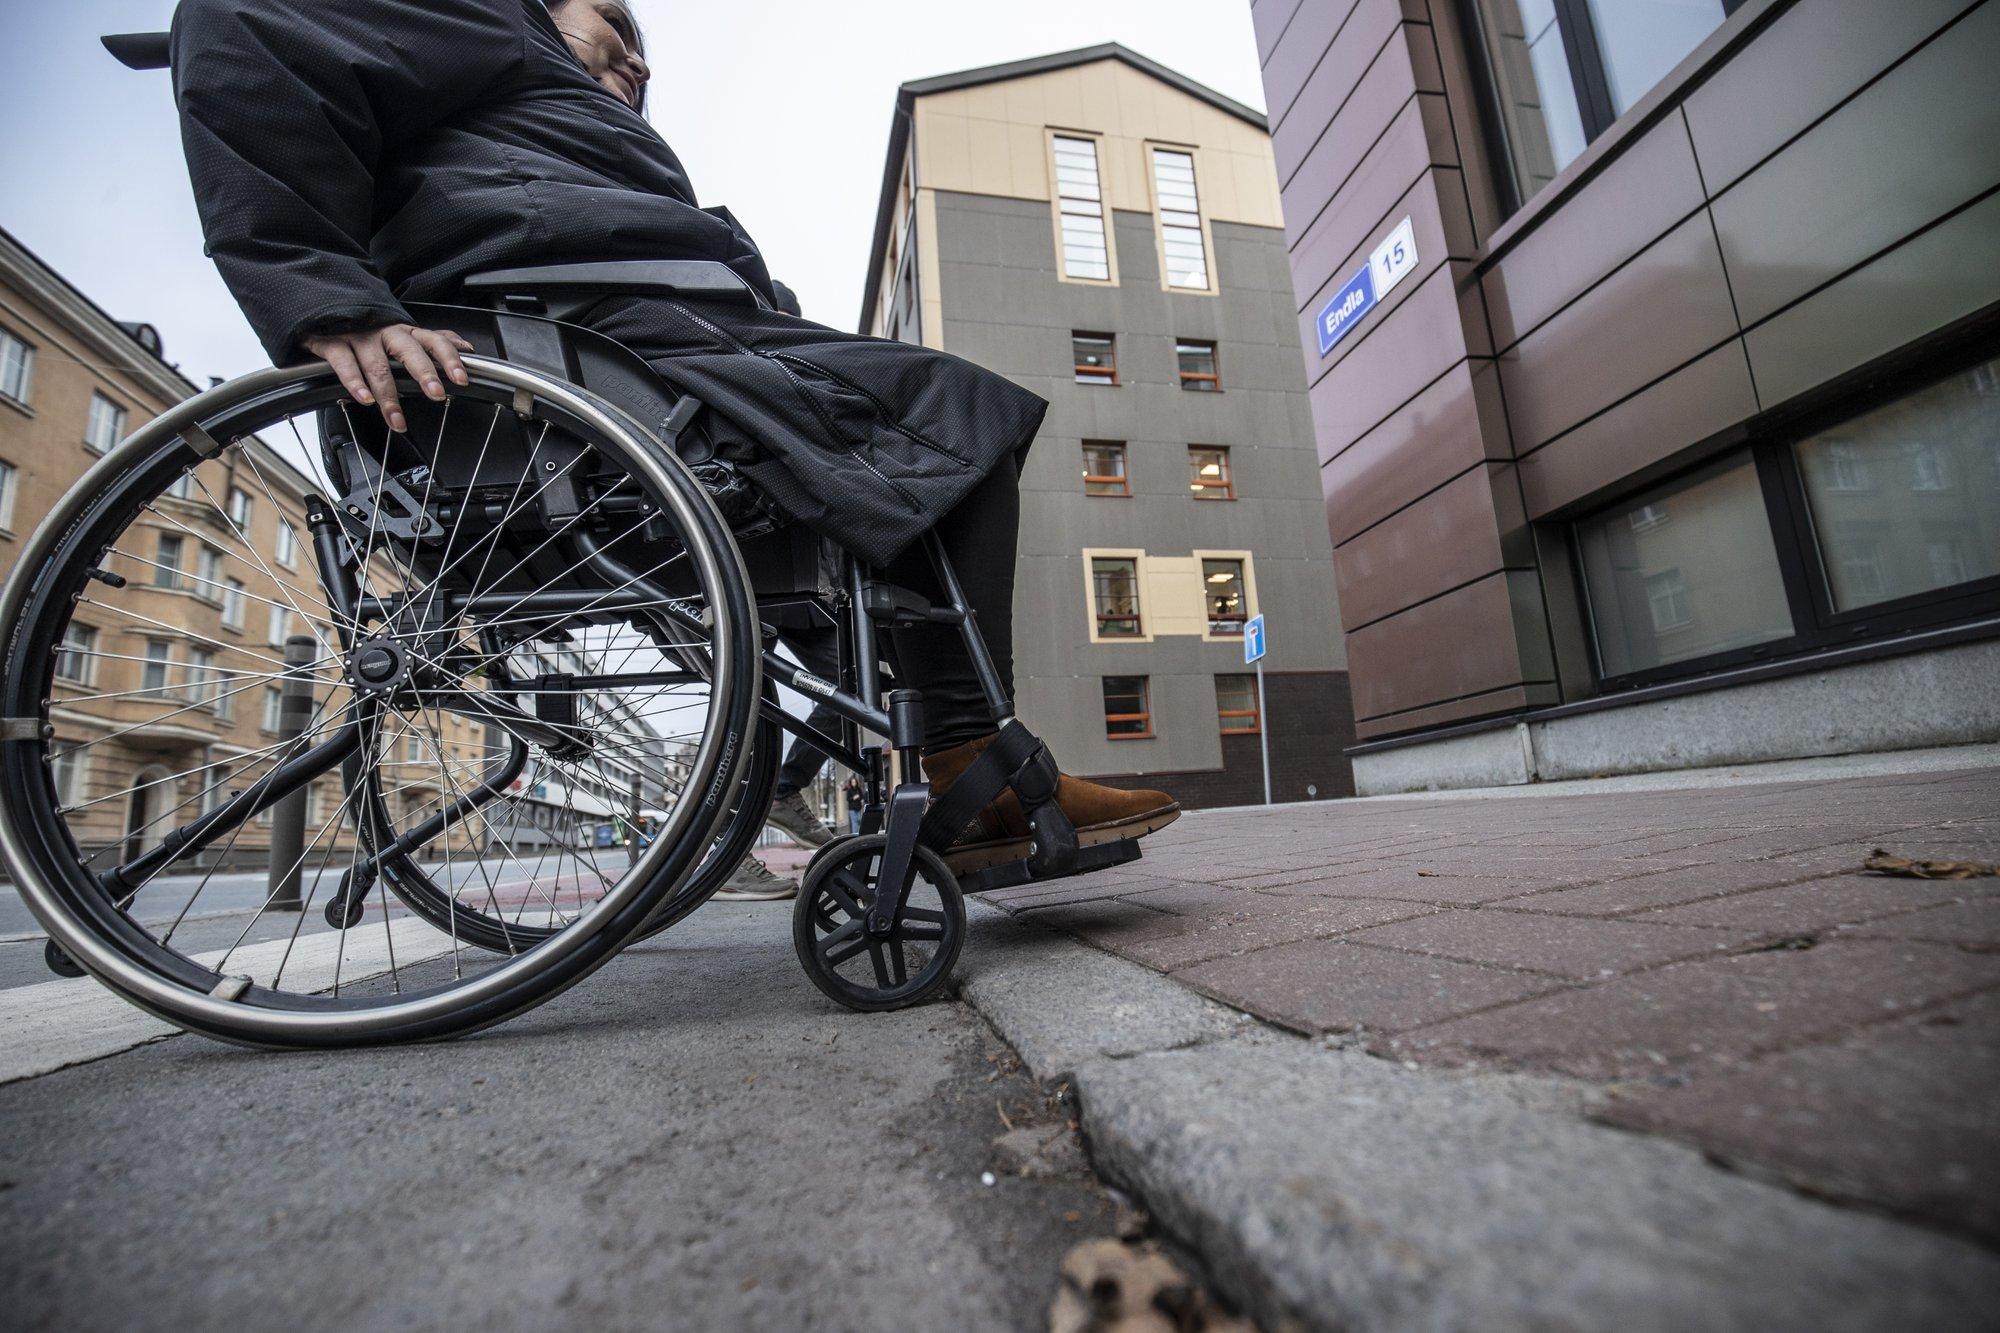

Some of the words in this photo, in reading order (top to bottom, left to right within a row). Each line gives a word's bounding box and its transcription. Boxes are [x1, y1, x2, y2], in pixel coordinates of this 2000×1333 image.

[1326, 288, 1365, 335] Endla
[1383, 241, 1404, 273] 15
[601, 375, 667, 422] panthe
[706, 731, 737, 807] panthera
